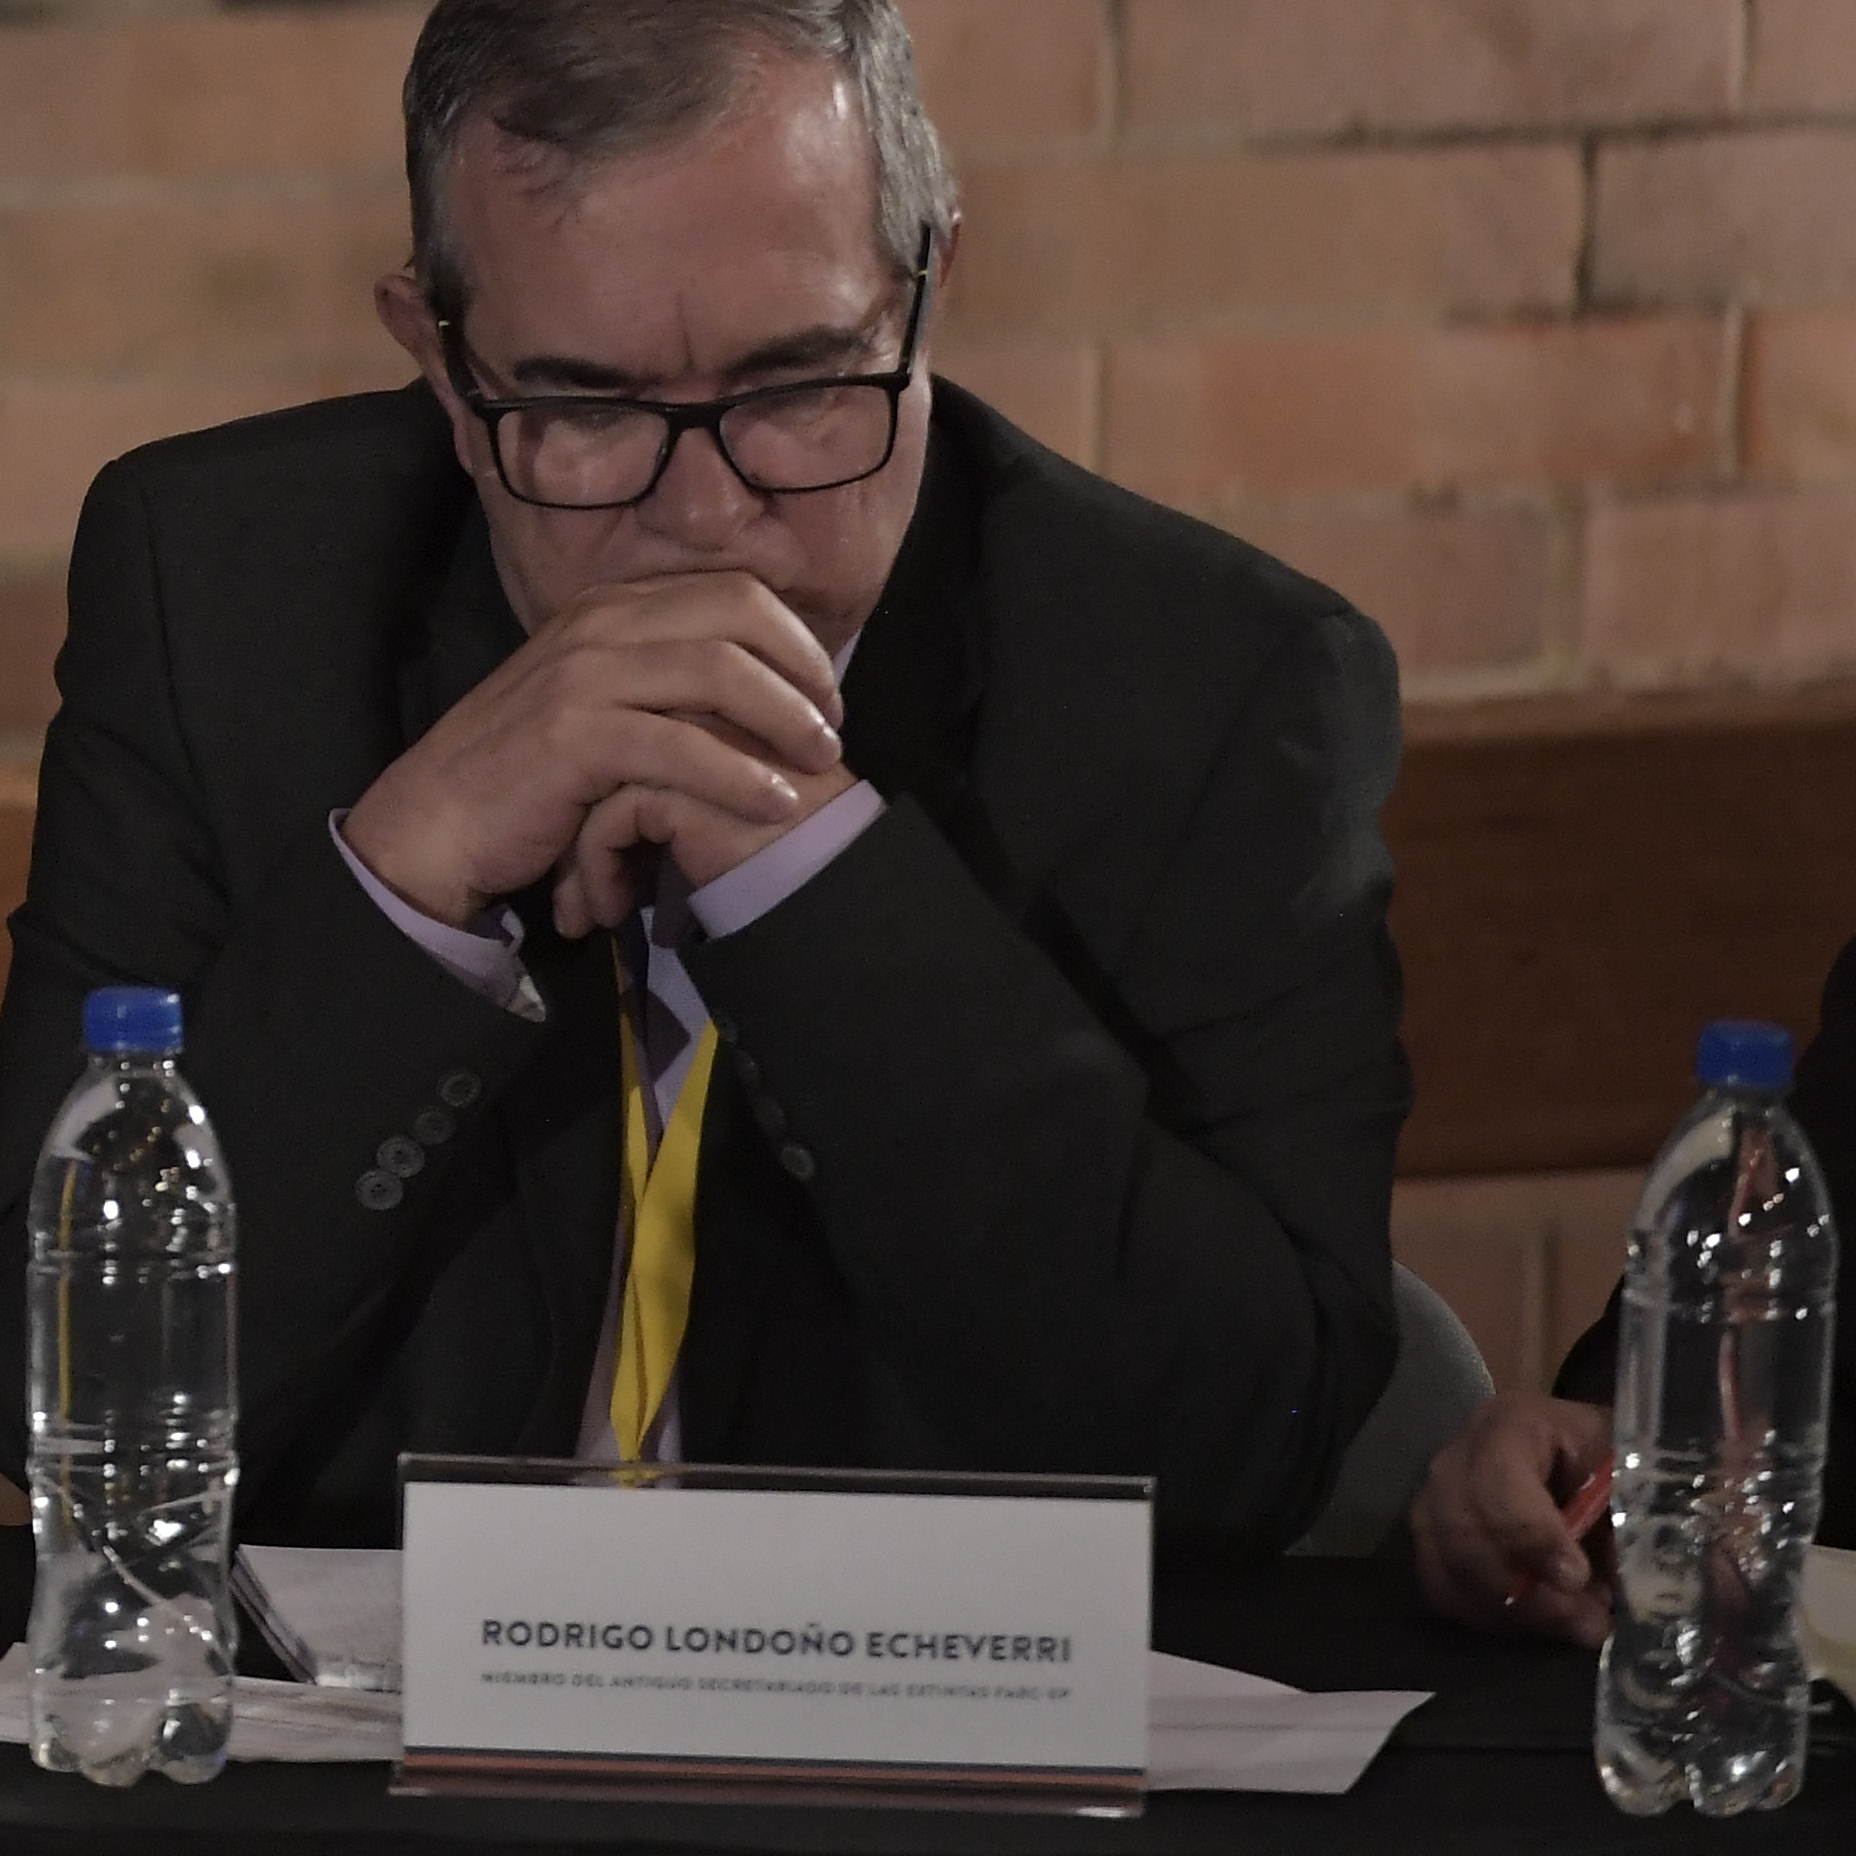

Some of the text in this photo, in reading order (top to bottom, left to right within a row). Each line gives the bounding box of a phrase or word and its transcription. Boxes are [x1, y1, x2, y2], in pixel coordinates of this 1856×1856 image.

[481, 1618, 1071, 1663] RODRIGO LONDOÑO ECHEVERRI
